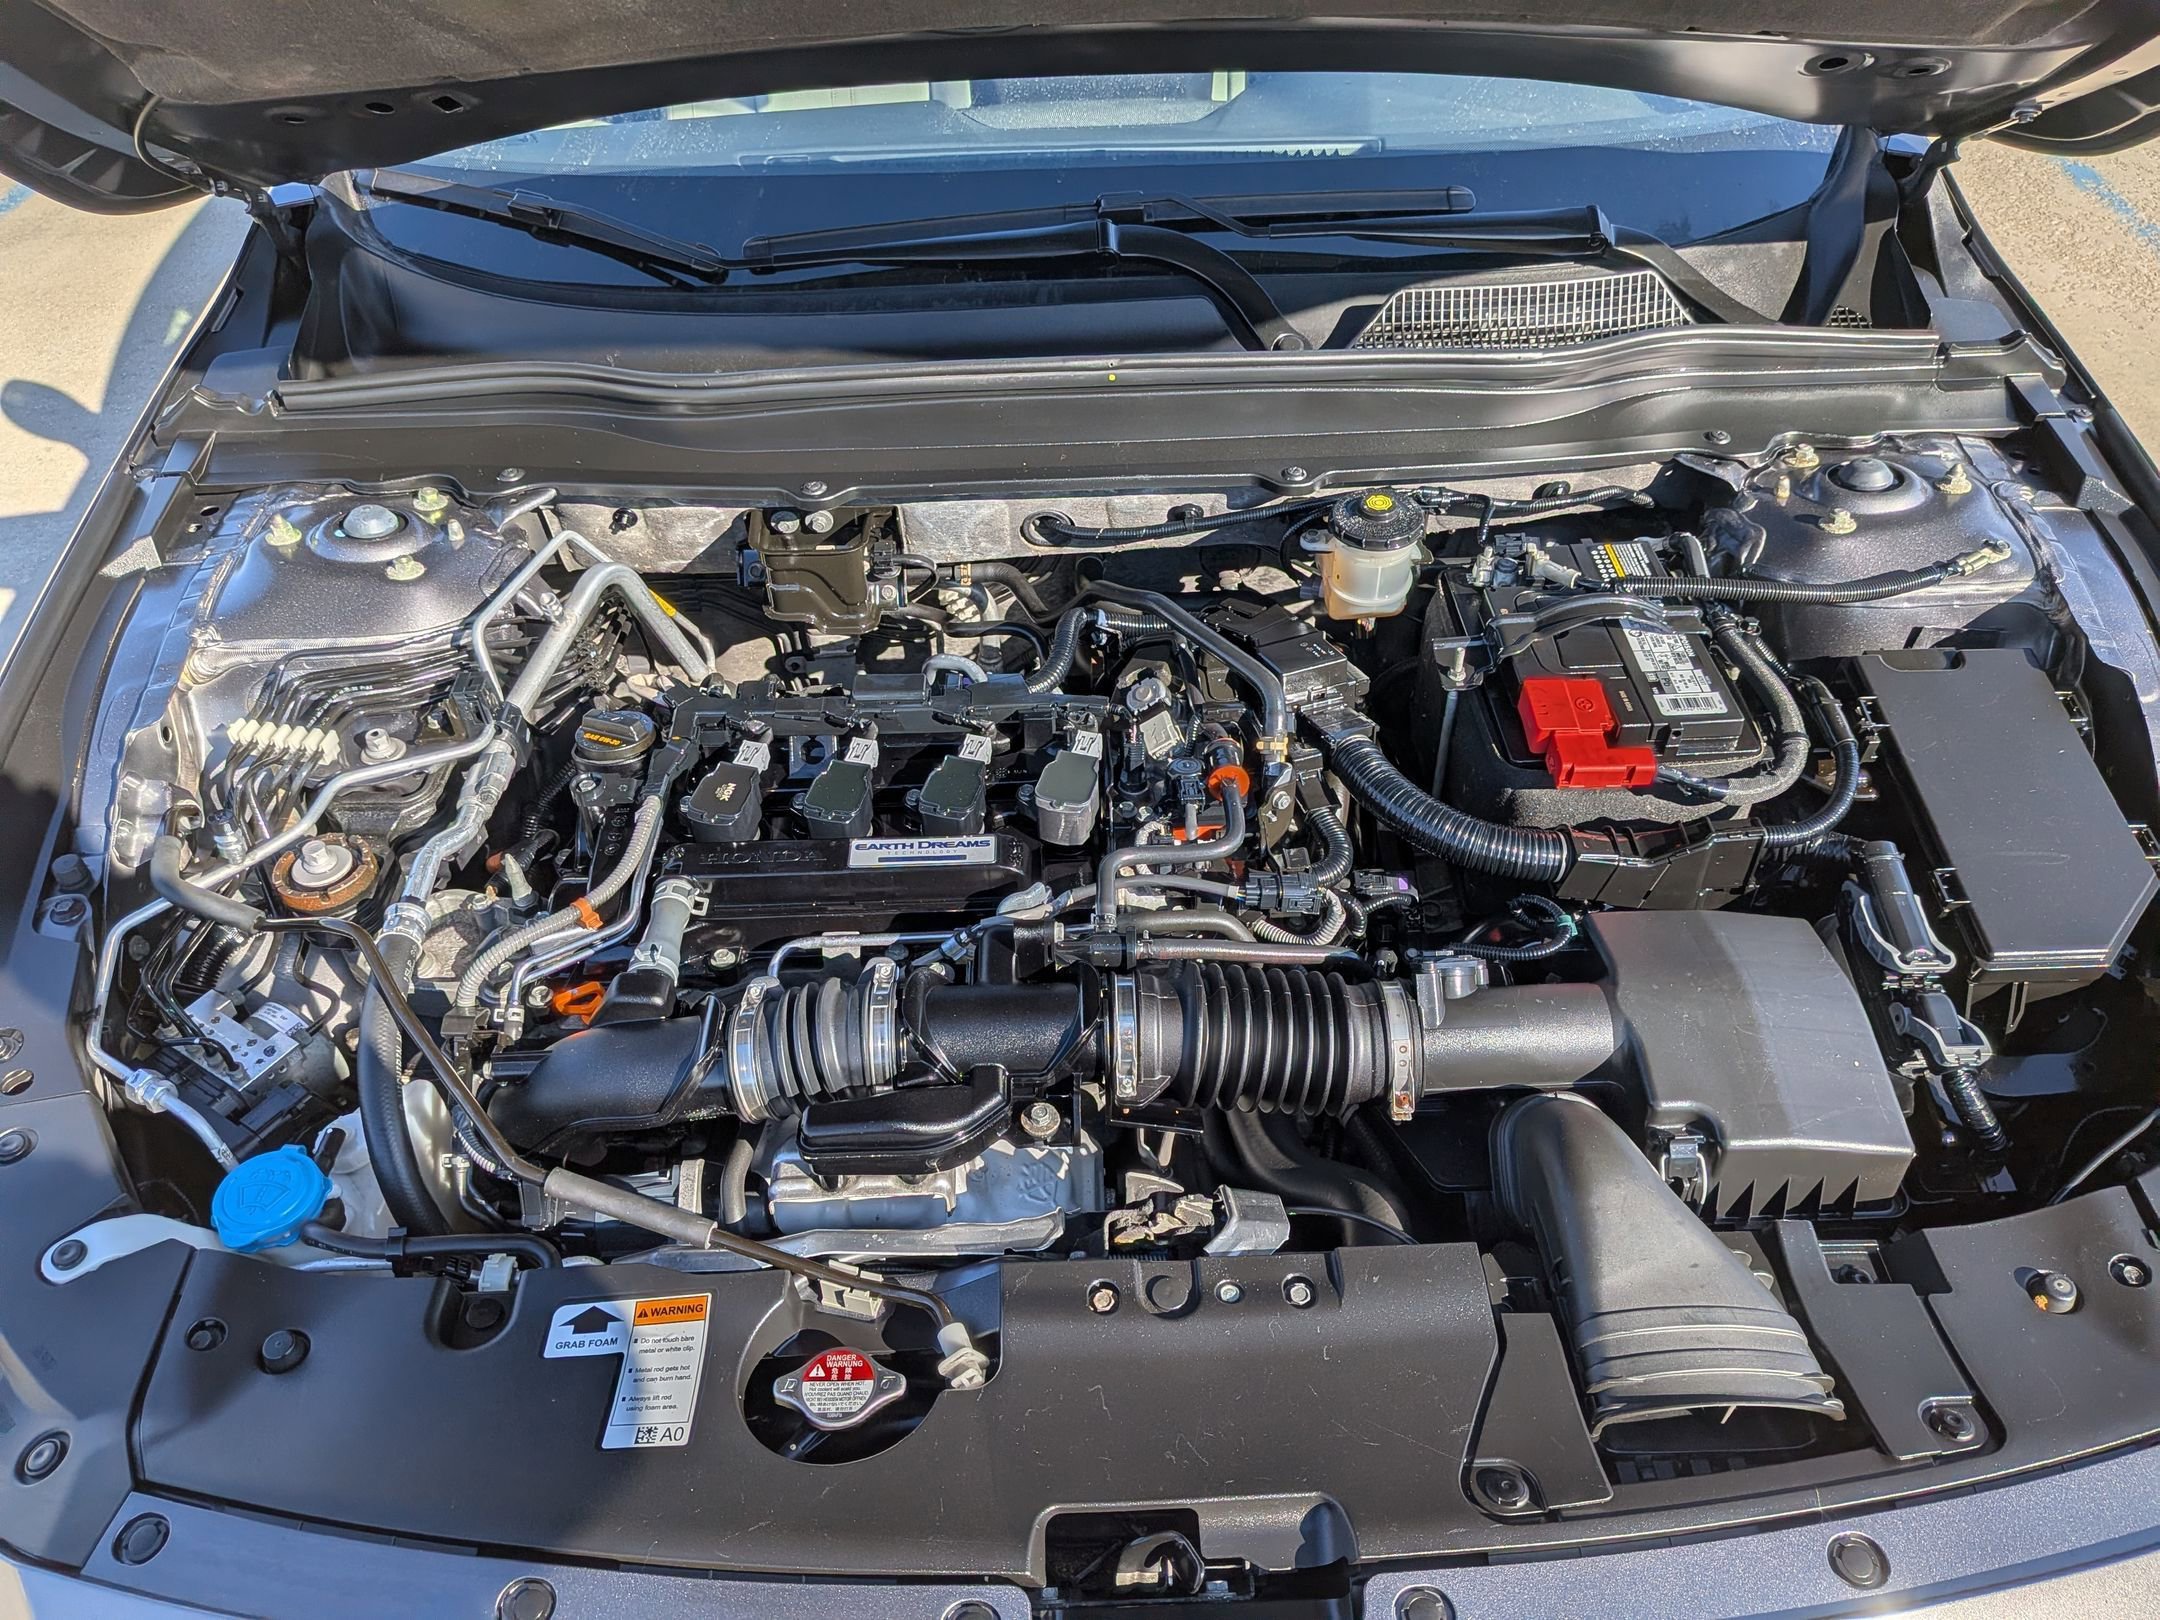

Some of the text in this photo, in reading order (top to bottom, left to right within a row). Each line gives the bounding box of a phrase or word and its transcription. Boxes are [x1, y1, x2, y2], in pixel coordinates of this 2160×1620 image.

[1661, 677, 1672, 687] Pb
[583, 732, 600, 741] SAE
[720, 782, 737, 801] NGK
[855, 839, 991, 851] EARTH DREAMS
[702, 849, 827, 865] HONDA
[650, 1303, 704, 1317] WARNING
[555, 1337, 618, 1350] GRAB FOAM
[826, 1360, 863, 1368] WARNUNG
[660, 1426, 684, 1442] A0
